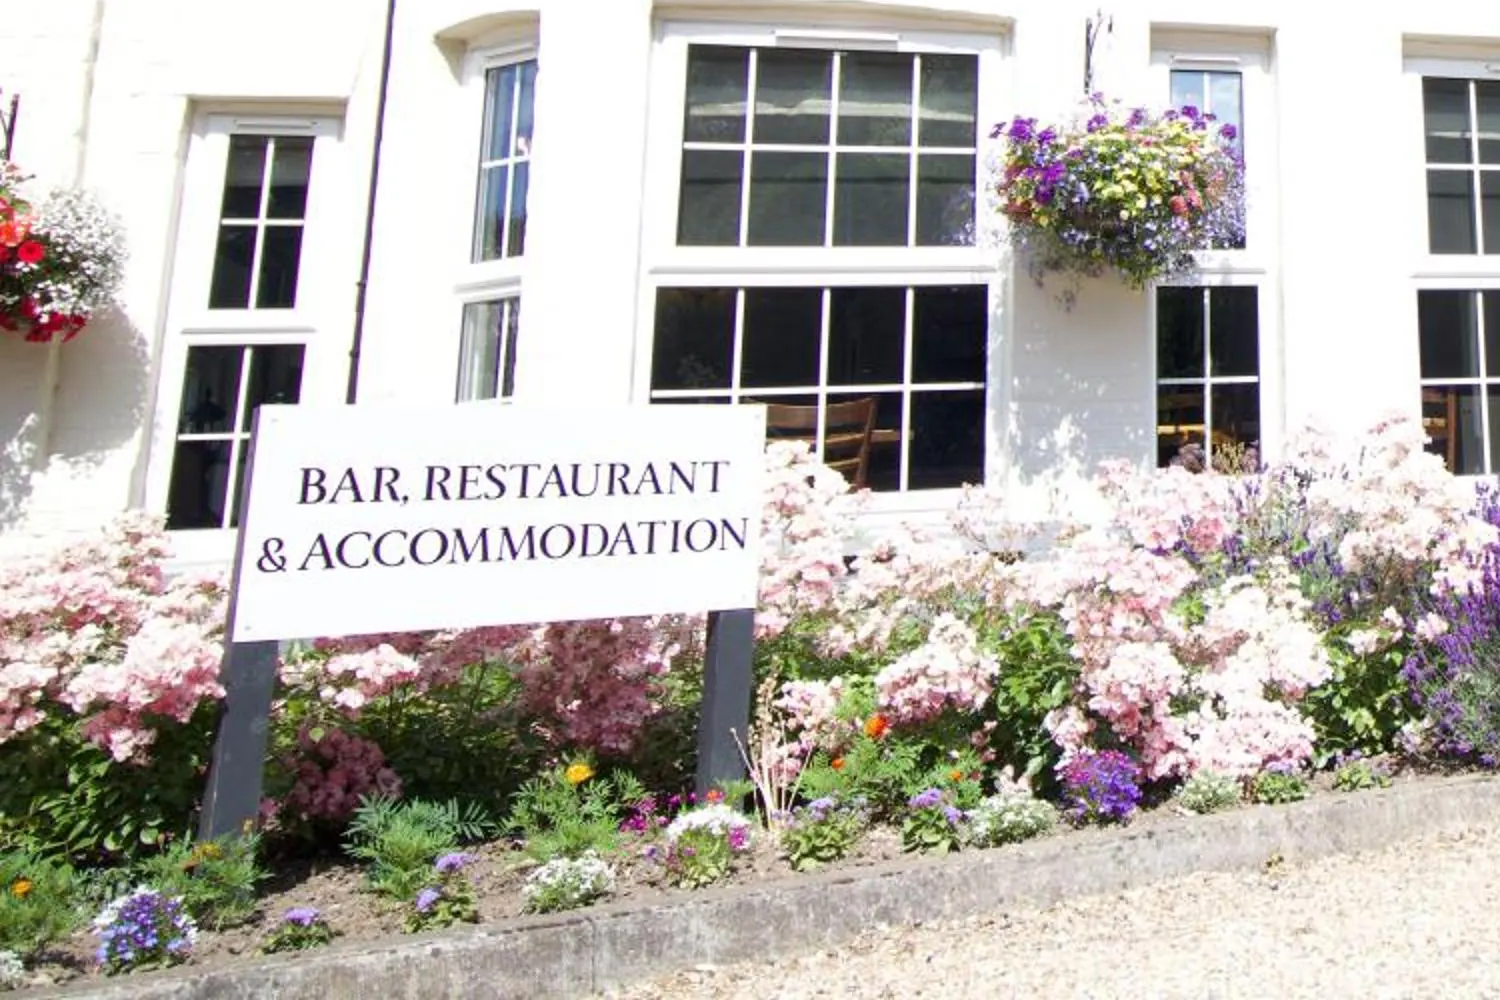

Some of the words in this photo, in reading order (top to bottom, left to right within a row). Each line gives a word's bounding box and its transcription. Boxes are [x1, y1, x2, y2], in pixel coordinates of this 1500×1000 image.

[297, 466, 410, 507] BAR,
[422, 460, 731, 501] RESTAURANT
[256, 536, 288, 573] &
[297, 517, 750, 571] ACCOMMODATION
